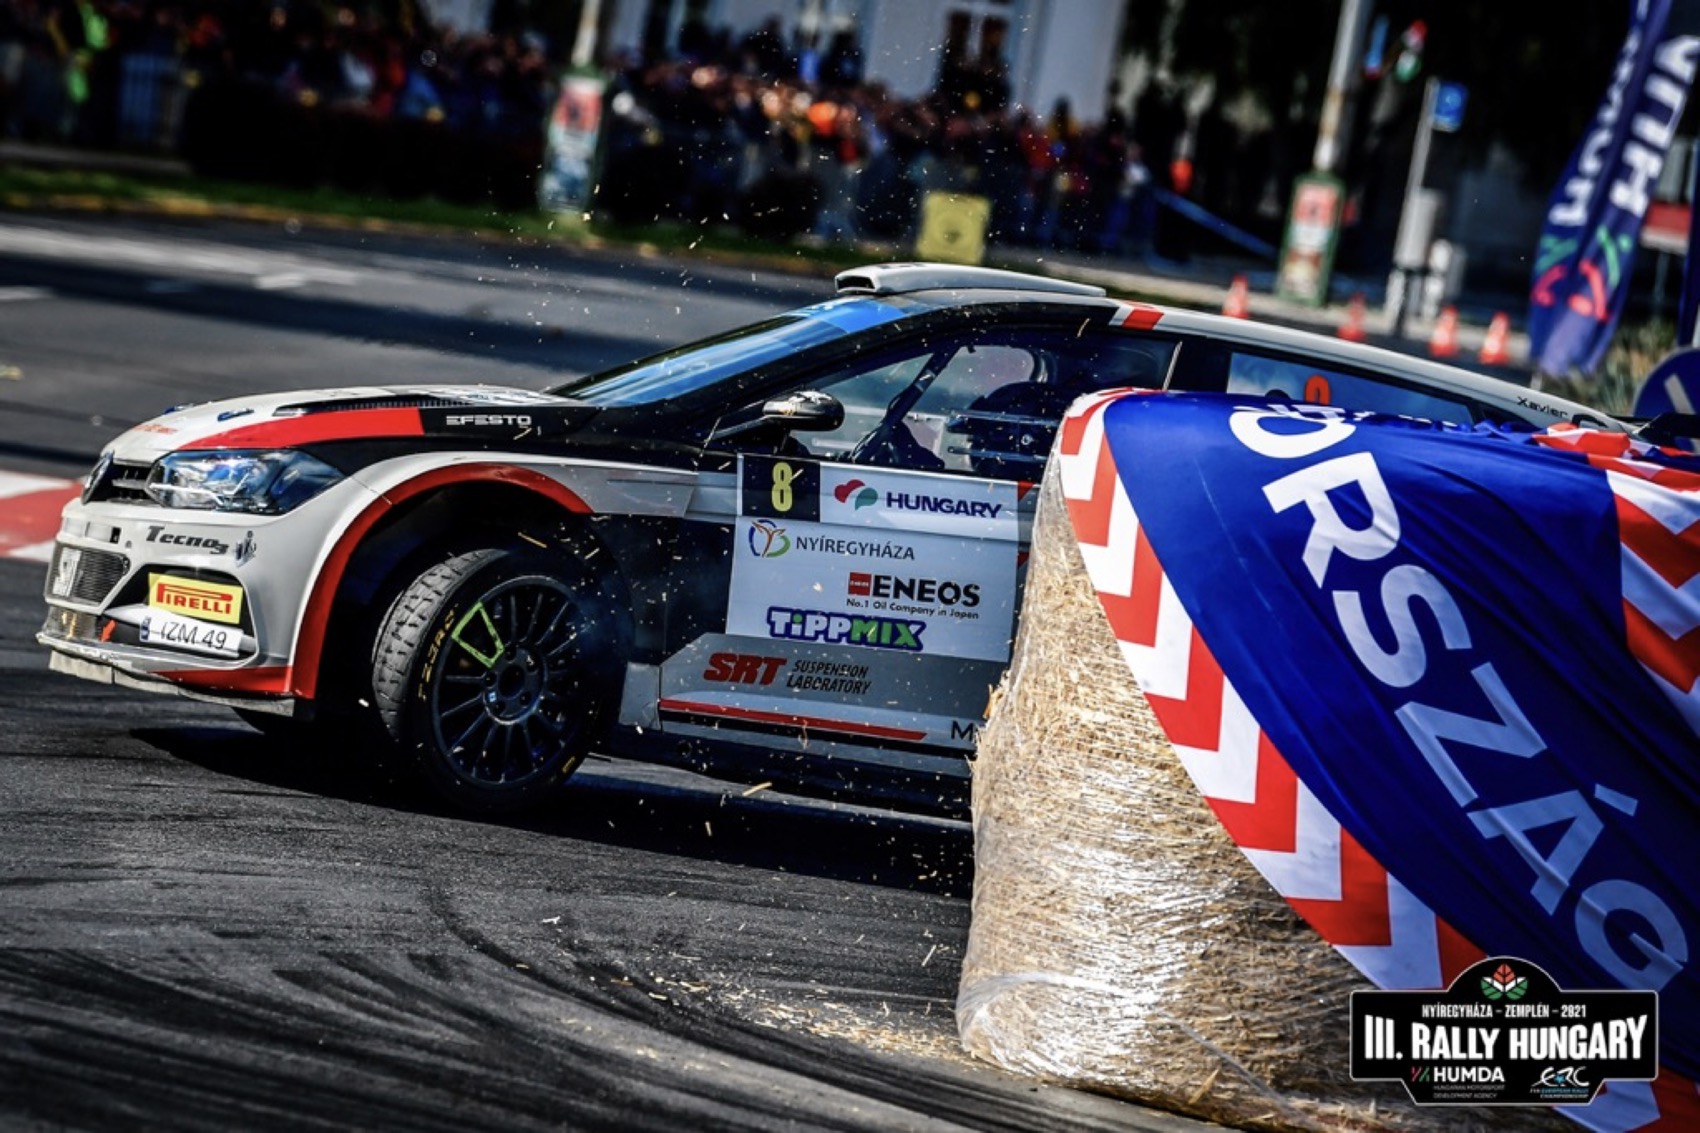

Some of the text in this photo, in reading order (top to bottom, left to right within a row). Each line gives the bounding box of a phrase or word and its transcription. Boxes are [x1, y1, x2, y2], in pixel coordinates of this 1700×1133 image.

[1517, 396, 1568, 418] Xavier
[446, 415, 532, 426] EFESTO
[772, 462, 794, 512] 8
[886, 491, 1002, 519] HUNGARY
[796, 535, 915, 561] NYÍREGYHÁZA
[156, 583, 233, 614] PIRELLI
[873, 574, 980, 607] ENEOS
[873, 601, 887, 610] Oil
[889, 603, 935, 616] Company
[938, 606, 947, 616] in
[950, 609, 979, 620] Japan
[703, 653, 787, 686] SRT
[792, 659, 869, 678] SUSPENSION
[786, 674, 872, 695] LABORATORY
[1229, 404, 1688, 991] ORSZÁG
[951, 720, 974, 742] M
